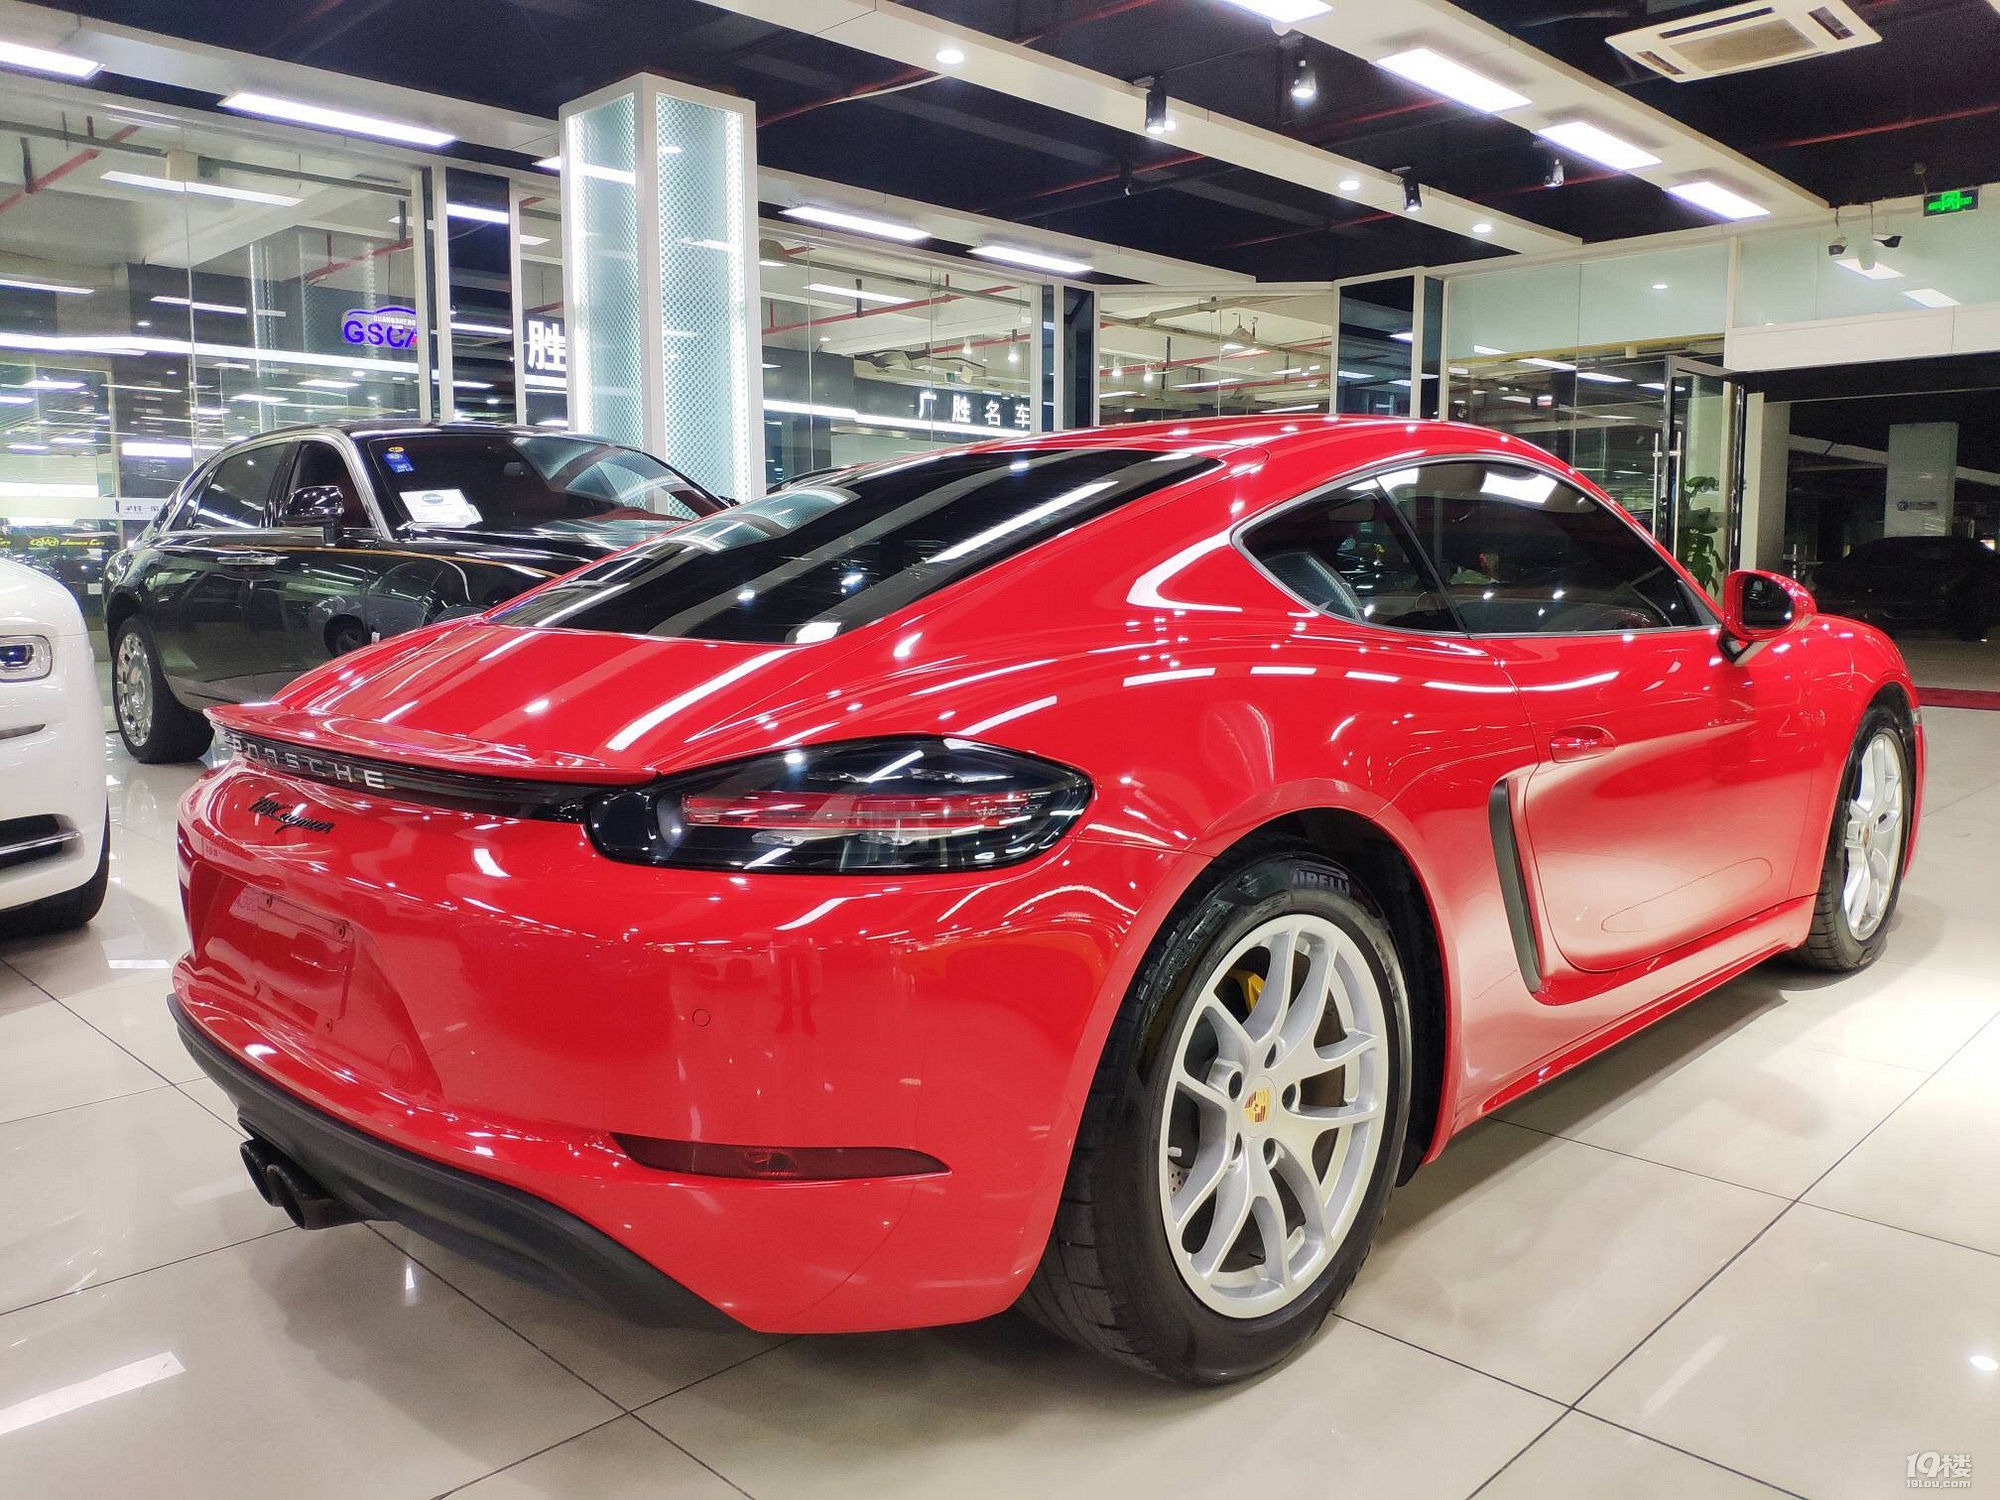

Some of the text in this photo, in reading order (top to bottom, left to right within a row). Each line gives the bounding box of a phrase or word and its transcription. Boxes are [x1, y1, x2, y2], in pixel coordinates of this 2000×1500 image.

[527, 320, 567, 371] 胜
[918, 390, 1031, 428] 广胜名车
